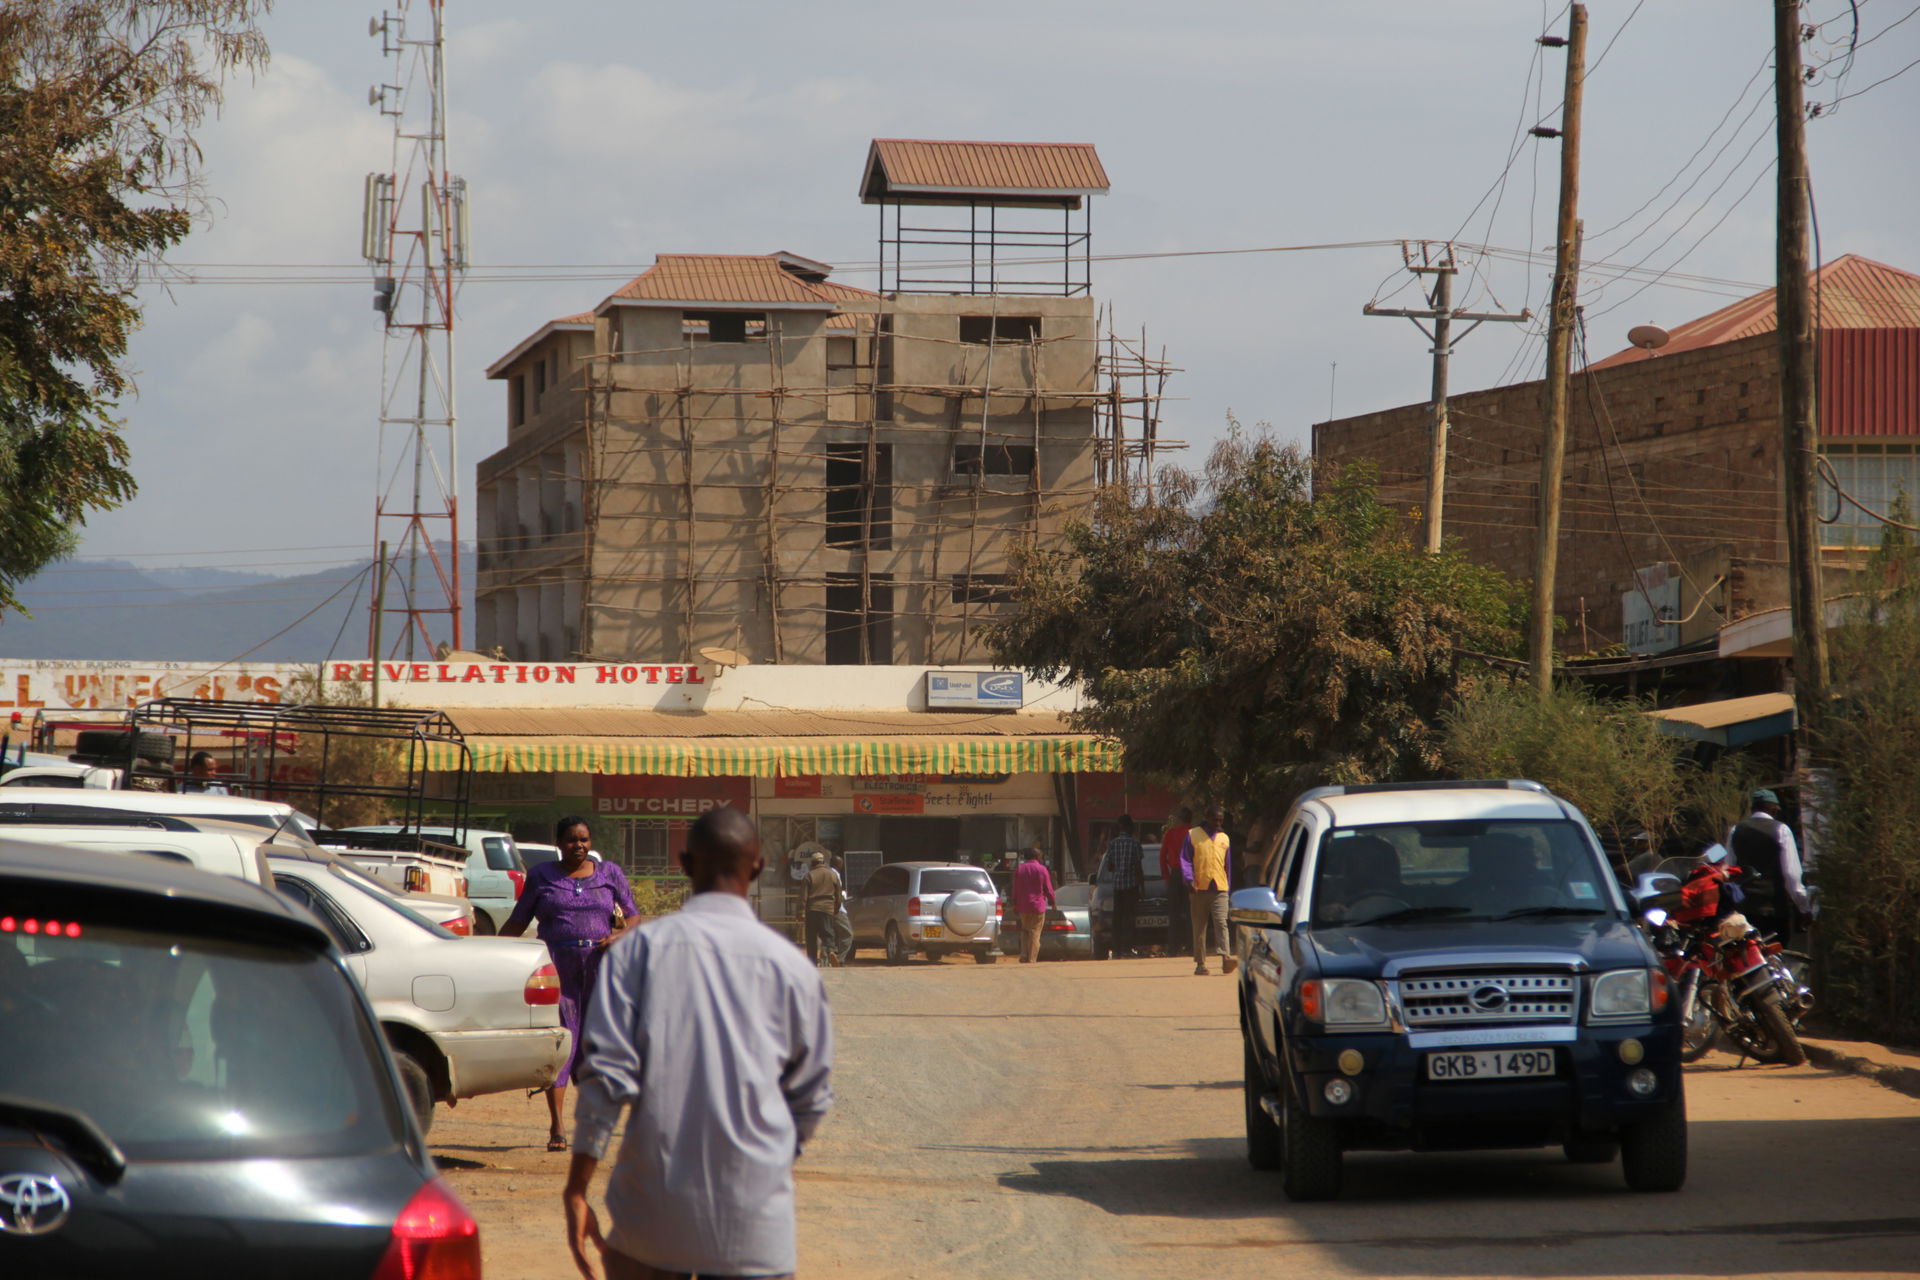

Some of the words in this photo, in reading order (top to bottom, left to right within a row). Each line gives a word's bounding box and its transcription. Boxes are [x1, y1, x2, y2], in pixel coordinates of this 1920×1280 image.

[332, 663, 576, 683] REVELATION
[596, 665, 705, 684] HOTEL
[598, 798, 733, 812] BUTCHERY
[1432, 1054, 1477, 1077] GKB
[1494, 1052, 1551, 1074] 149D
